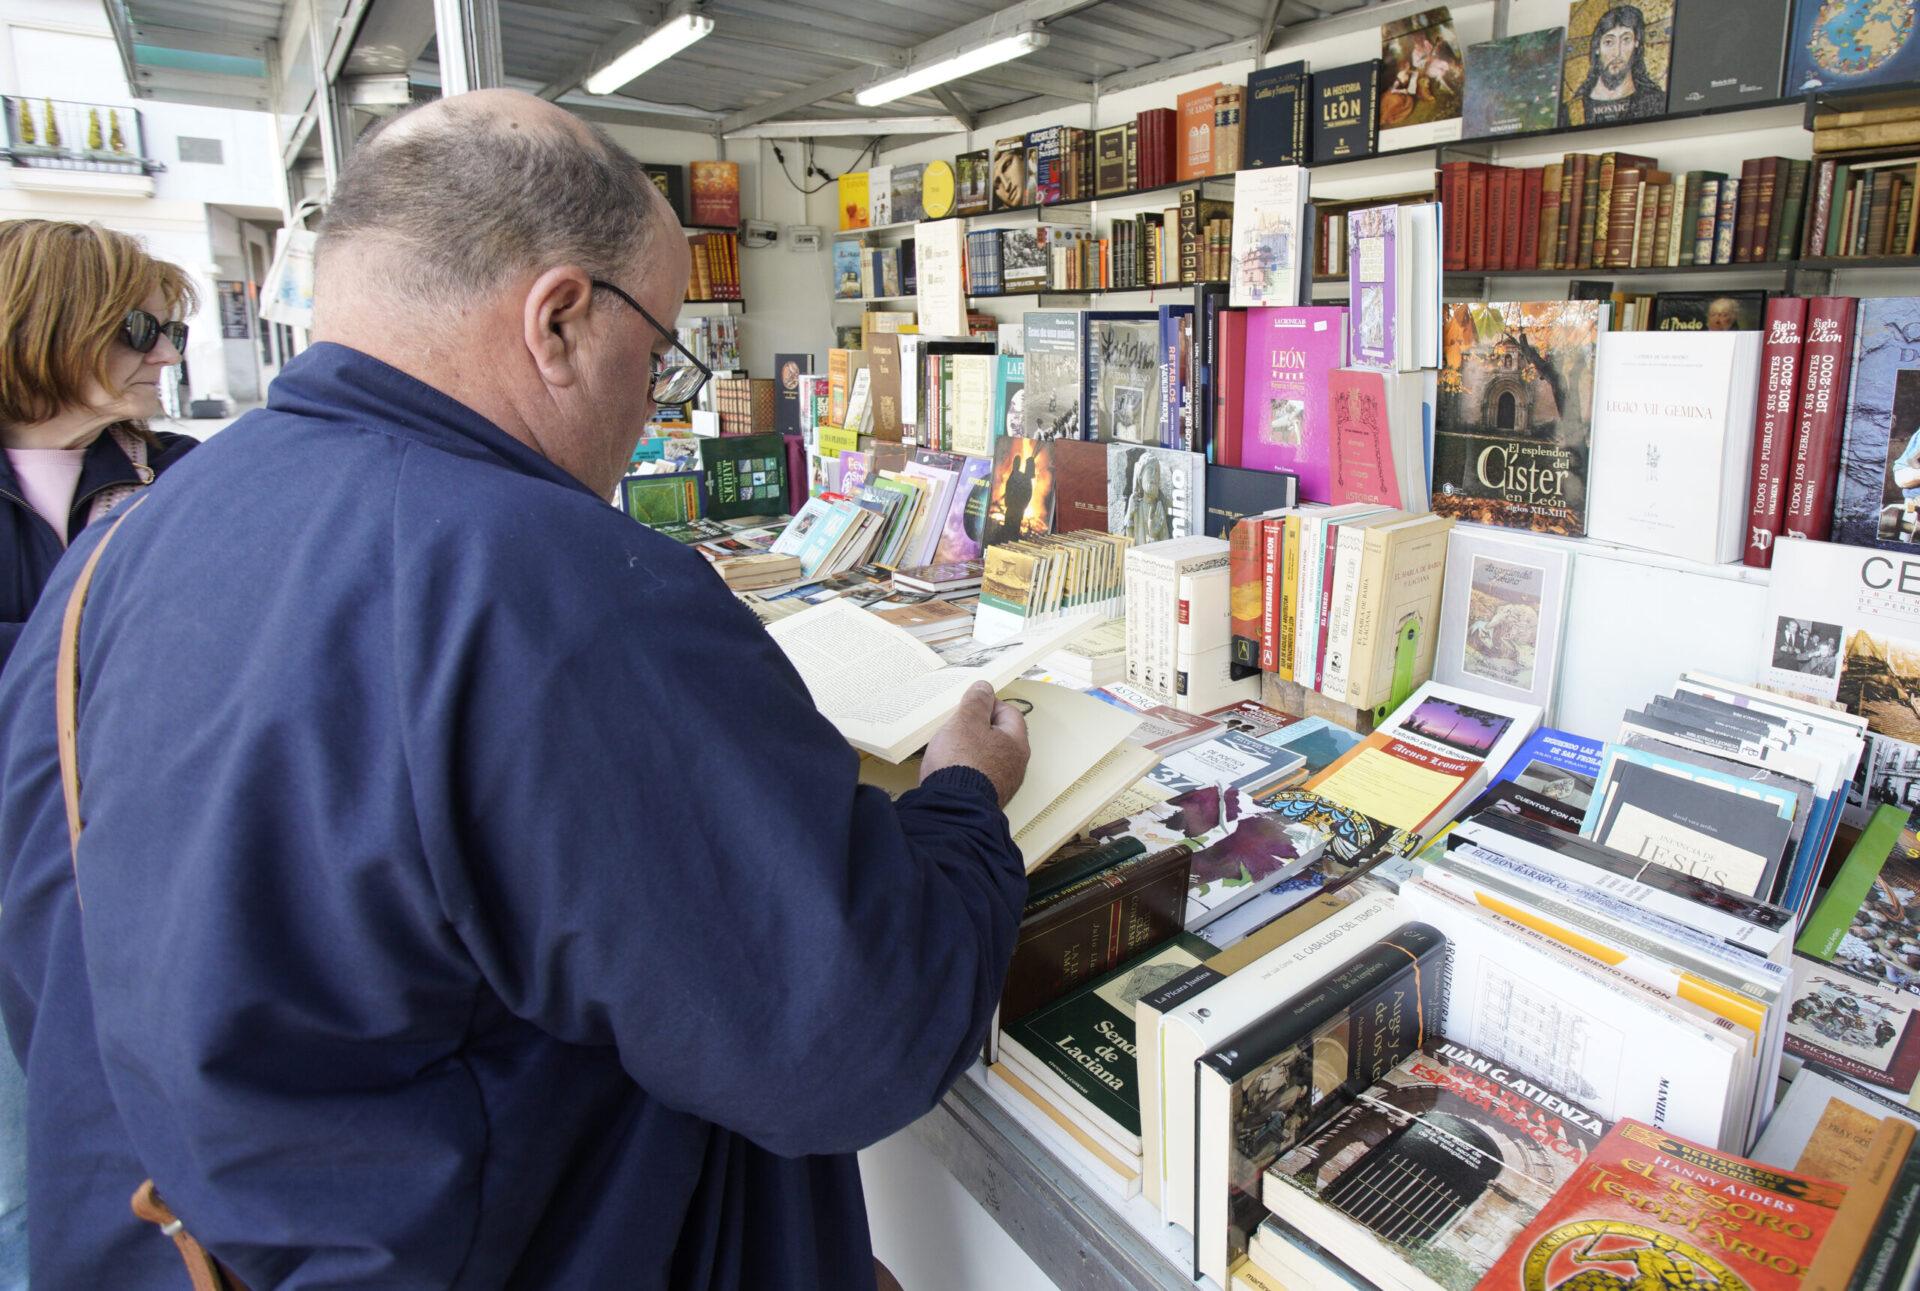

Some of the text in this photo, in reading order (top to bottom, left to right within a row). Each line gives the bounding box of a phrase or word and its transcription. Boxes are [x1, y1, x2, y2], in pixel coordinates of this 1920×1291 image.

[1661, 317, 1703, 331] El Prado
[1168, 346, 1176, 403] RETABLOS
[1271, 347, 1307, 369] LEÓN
[1769, 355, 1781, 392] GENTES
[1808, 354, 1820, 392] GENTES
[1777, 356, 1794, 413] 1901-2000
[1816, 355, 1834, 413] 1901-2000
[1606, 400, 1713, 420] LEGIO VII GEMINA
[1767, 394, 1776, 409] SUS
[1805, 394, 1815, 409] SUS
[1509, 443, 1570, 458] El esplendor
[1762, 422, 1774, 461] PUEBLOS
[1798, 420, 1811, 460] PUEBLOS
[1477, 445, 1569, 496] Císter
[1552, 458, 1569, 469] del
[1759, 463, 1769, 480] LOS
[1795, 463, 1805, 480] LOS
[1505, 492, 1566, 508] en León
[1505, 504, 1567, 518] siglos XII-XIII
[1753, 482, 1767, 515] TODOS
[1788, 482, 1802, 516] TODOS
[1267, 561, 1274, 573] DE
[1266, 575, 1274, 632] UNIVERSIDAD
[1320, 616, 1326, 626] EL
[1265, 635, 1272, 647] LA
[1392, 743, 1428, 762] Ateneo
[1147, 768, 1204, 789] 37
[1515, 794, 1569, 820] CUENTOS CON
[1293, 905, 1382, 961] EL CABALLERO DEL TEMPLO
[1502, 918, 1525, 932] ARTE
[1526, 929, 1545, 942] DEL
[1545, 938, 1623, 976] RENACIMIENTO
[1622, 974, 1639, 985] EN
[1155, 971, 1211, 1005] La Pícara Justina
[1441, 938, 1455, 1023] ARQUITECTURA
[1374, 1002, 1388, 1057] de los
[1388, 991, 1405, 1036] Auge
[1055, 1034, 1125, 1091] Laciana
[1094, 1046, 1119, 1063] de
[1787, 1037, 1800, 1047] LA
[1846, 1060, 1897, 1082] JUSTINA
[1436, 1043, 1604, 1137] JUAN G. ATIENZA
[1656, 1077, 1670, 1122] MANUEL
[1681, 1146, 1786, 1183] BESTSELLERS
[1654, 1156, 1795, 1213] HANNY ALDERS
